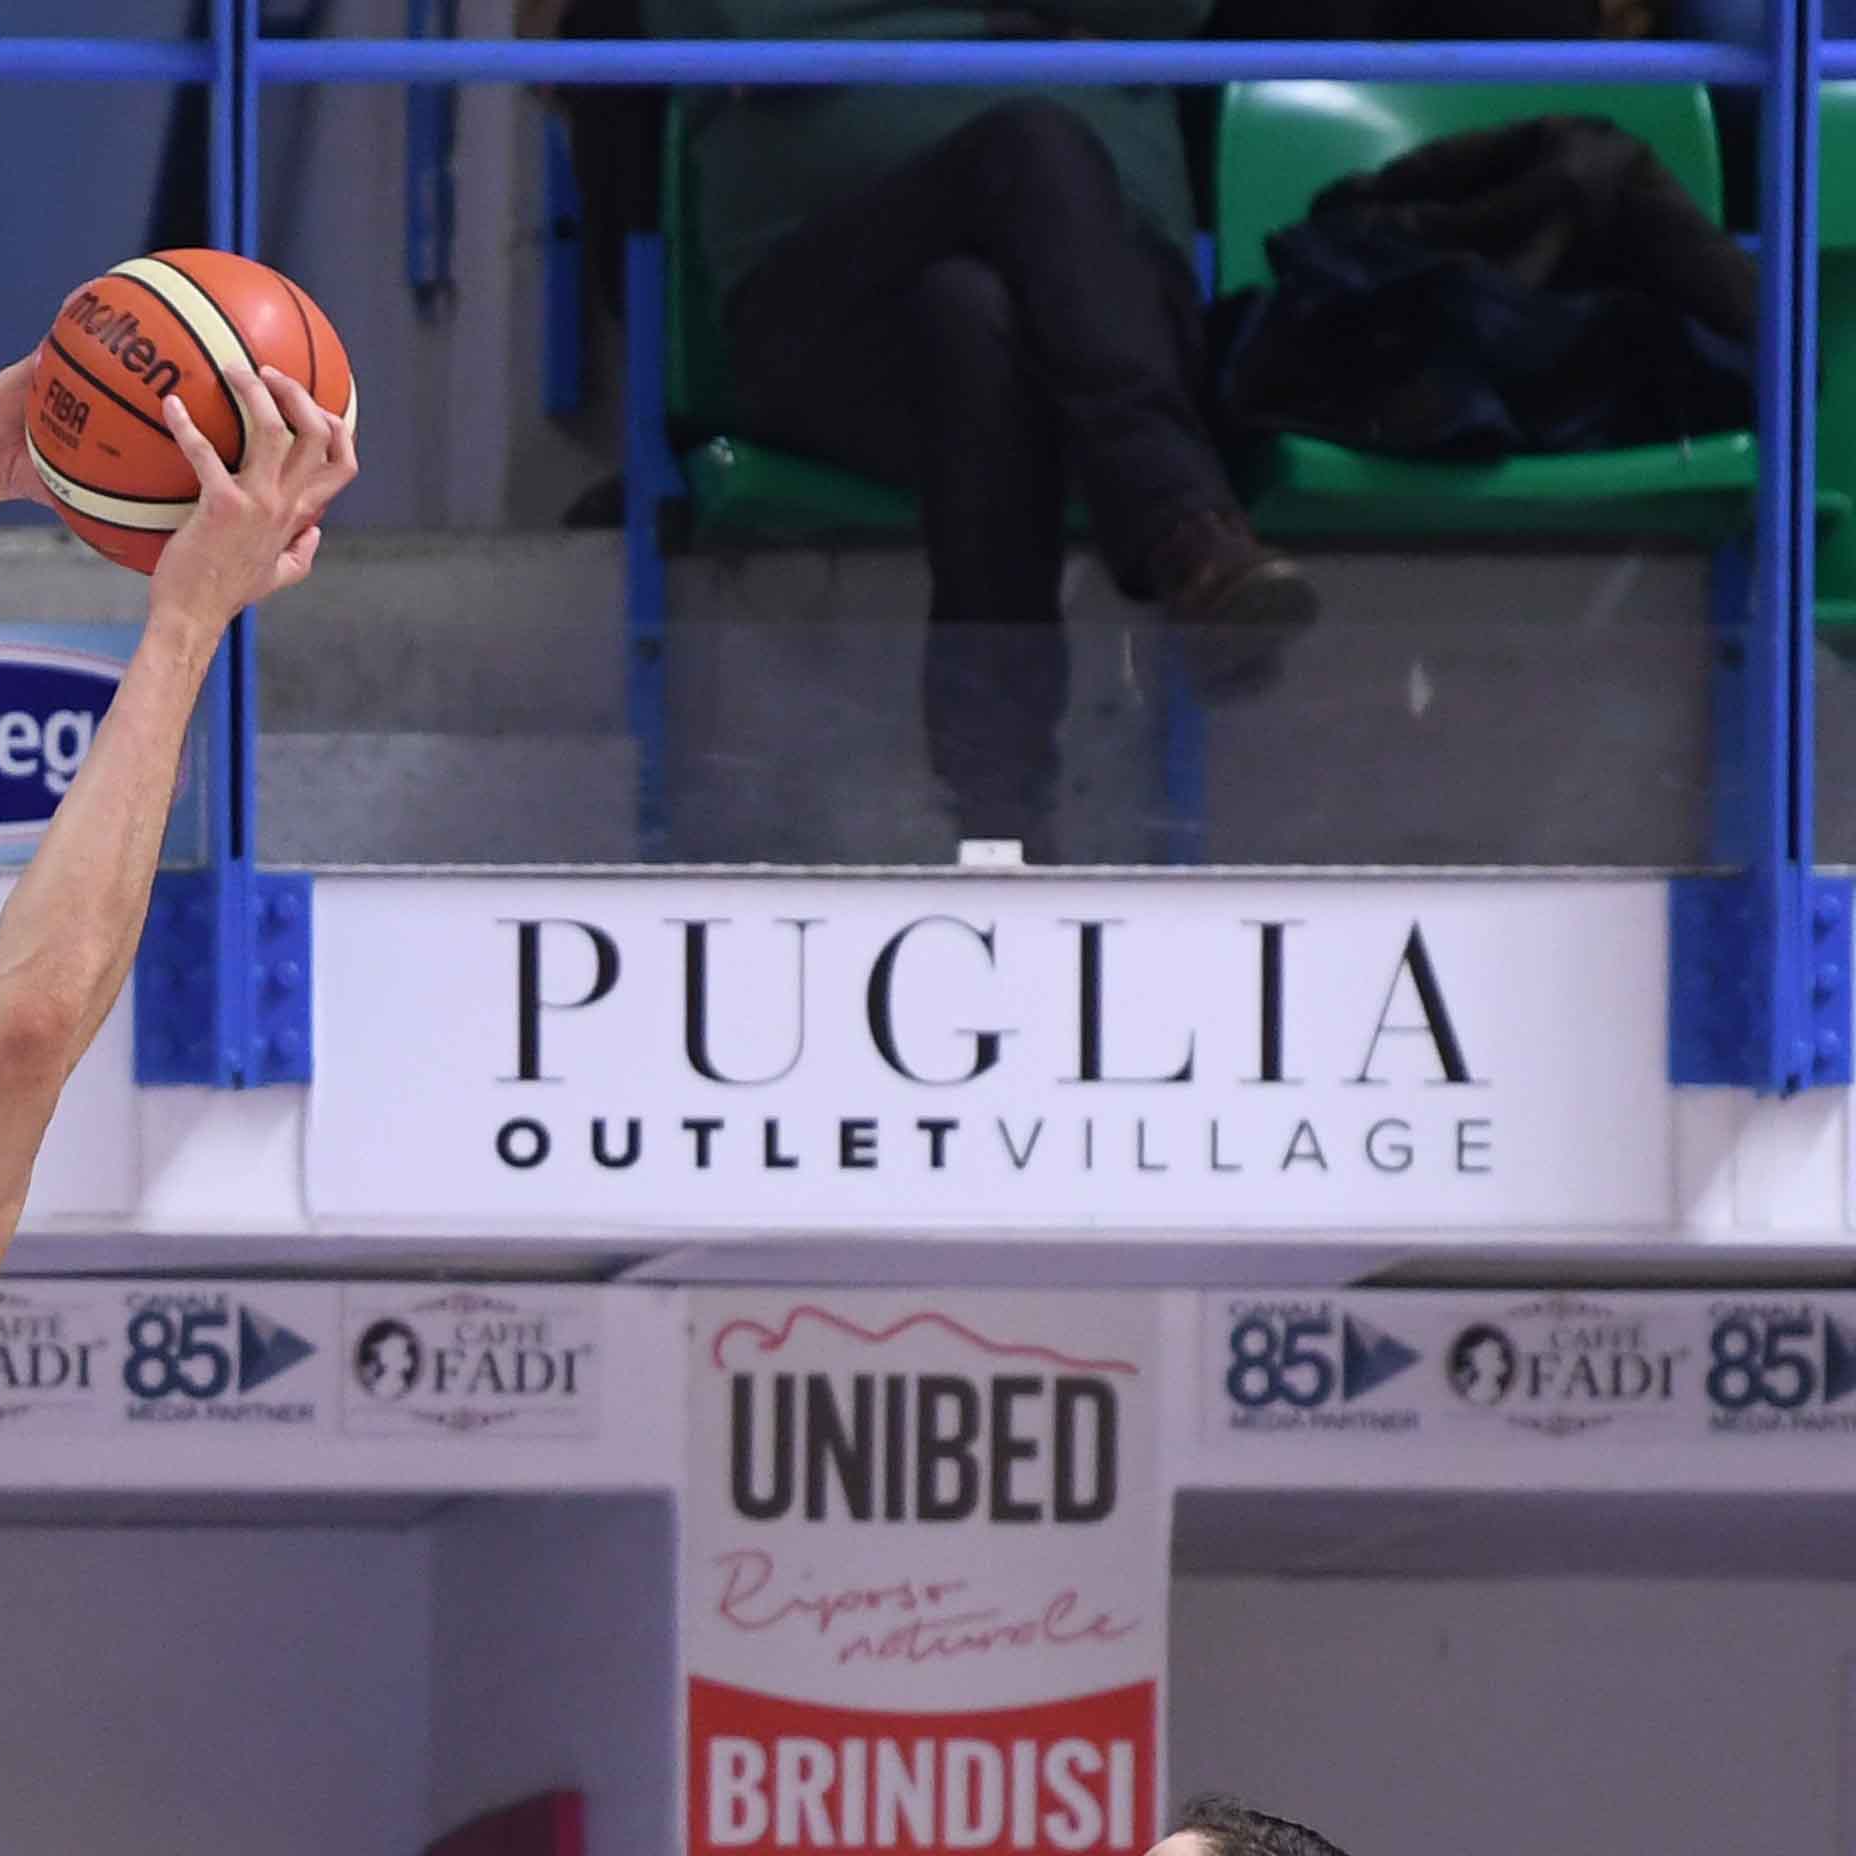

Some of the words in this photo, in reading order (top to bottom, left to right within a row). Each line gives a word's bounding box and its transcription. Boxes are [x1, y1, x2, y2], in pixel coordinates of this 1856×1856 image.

[63, 290, 182, 399] molten
[495, 914, 1494, 1086] PUGLIA
[122, 1310, 231, 1400] 85
[431, 1348, 578, 1395] FADI
[1226, 1318, 1333, 1409] 85
[1525, 1354, 1678, 1400] FADI
[1705, 1318, 1813, 1410] 85
[727, 1371, 1117, 1525] UNIBED
[706, 1732, 1134, 1851] BRINDISI
